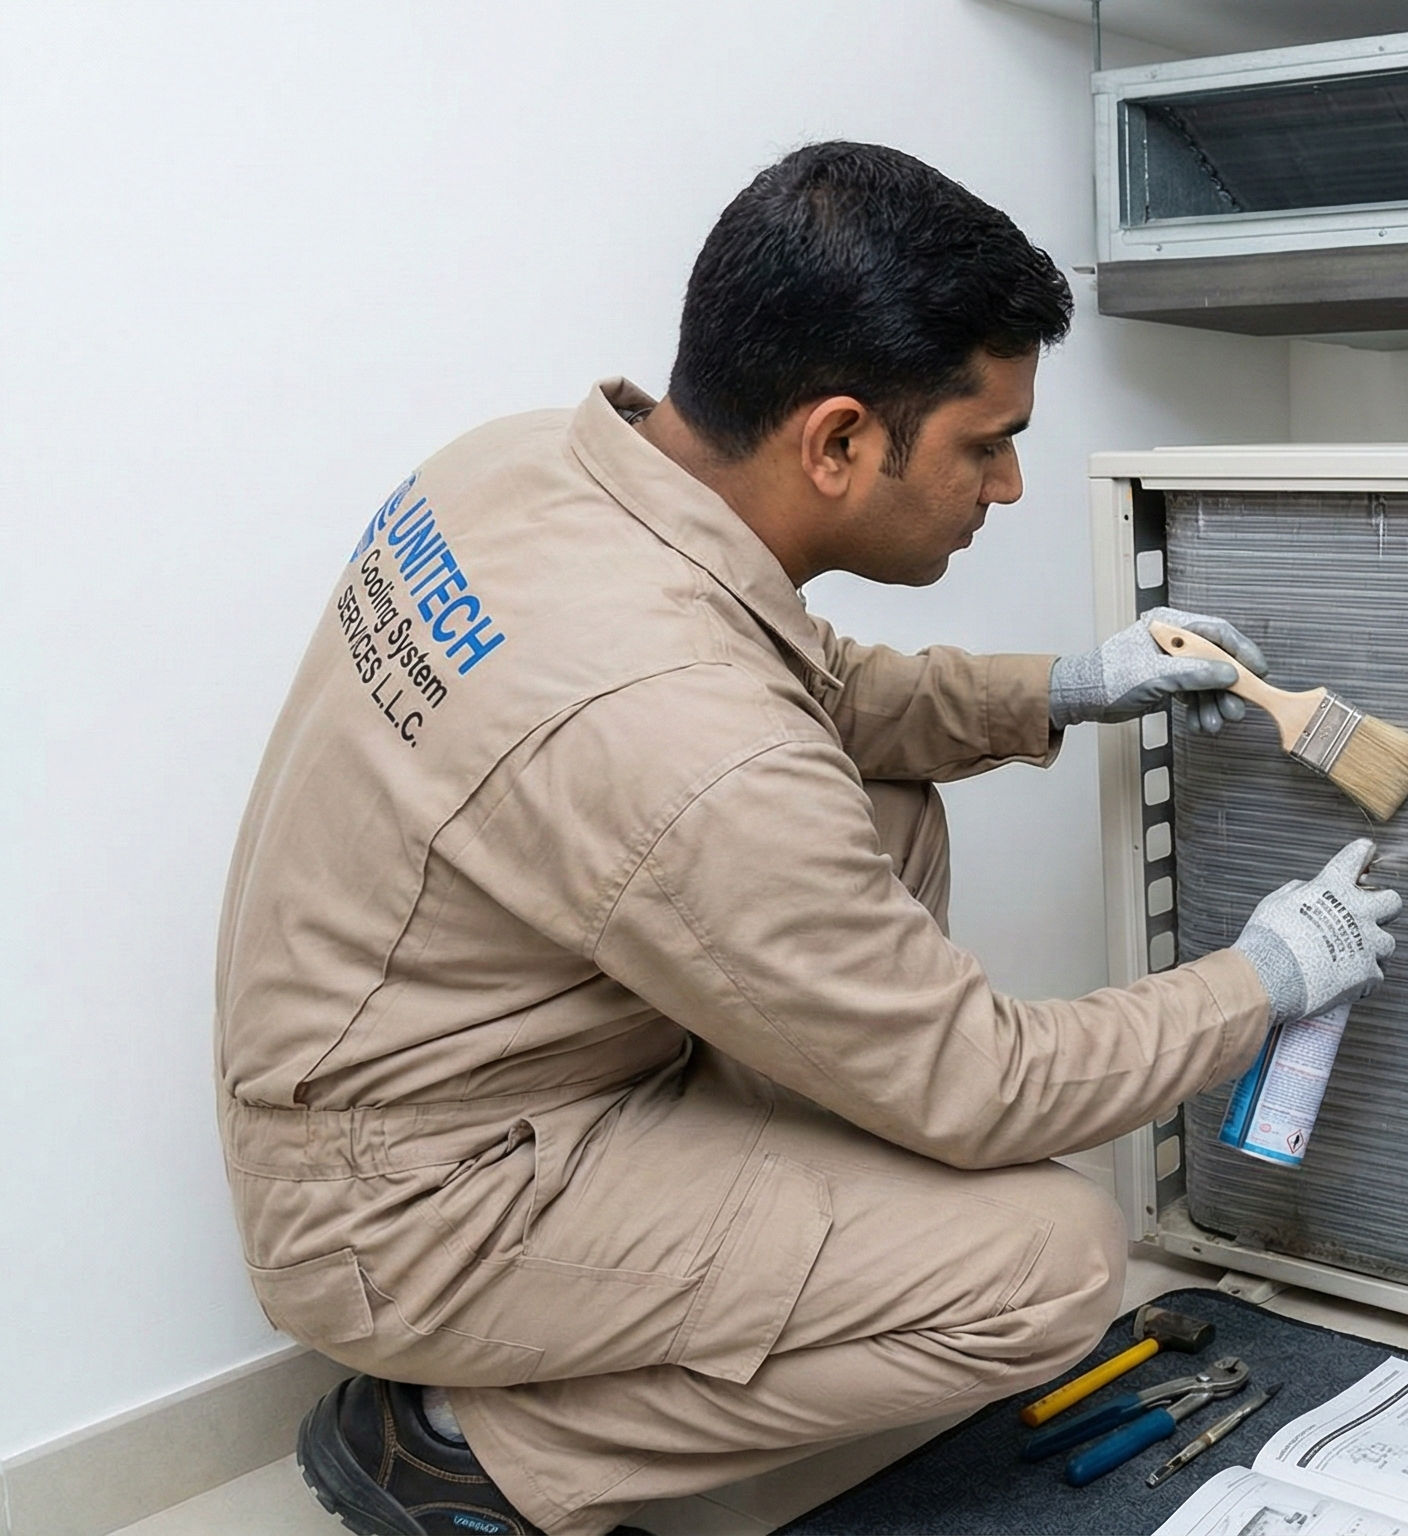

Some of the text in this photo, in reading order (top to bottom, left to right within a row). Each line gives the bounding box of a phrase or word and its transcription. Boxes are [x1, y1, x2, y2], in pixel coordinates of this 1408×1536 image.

[337, 584, 423, 747] SERVICES L.L.C.
[361, 549, 449, 708] Cooling System
[387, 497, 505, 675] UNITECH
